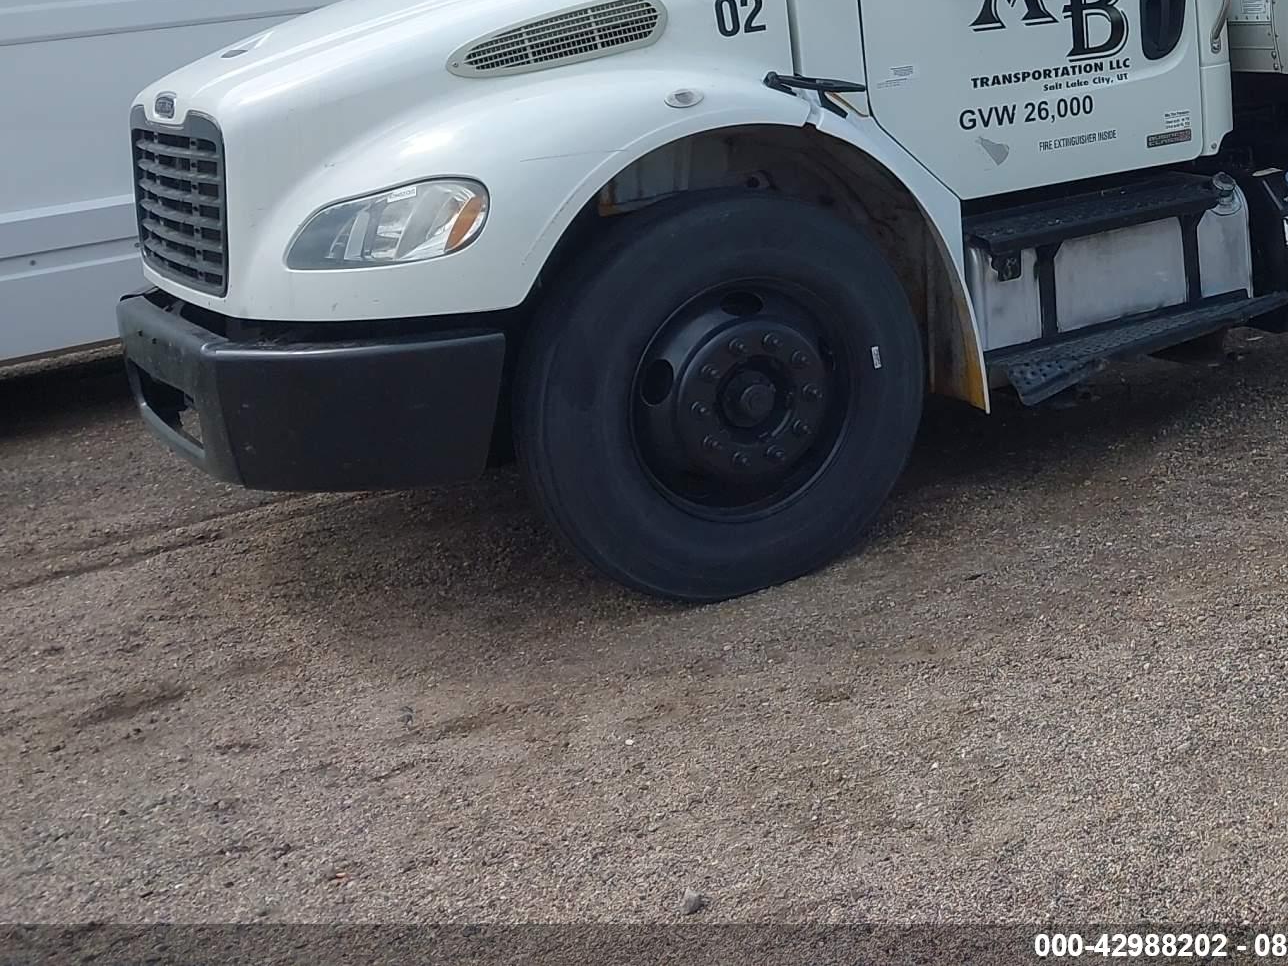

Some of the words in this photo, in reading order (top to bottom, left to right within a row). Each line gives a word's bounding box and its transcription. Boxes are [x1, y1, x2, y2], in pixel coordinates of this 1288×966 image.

[971, 62, 1104, 88] TRANSPORTATION
[1109, 58, 1130, 69] LLC
[1043, 83, 1062, 92] Salt
[1066, 79, 1089, 89] Lake
[1117, 72, 1129, 81] UT
[959, 104, 1017, 130] GVW
[1024, 95, 1093, 123] 26,000
[1039, 141, 1053, 151] FIRE
[1054, 132, 1097, 149] EXTINGUISHER
[1098, 129, 1117, 140] INSIDE
